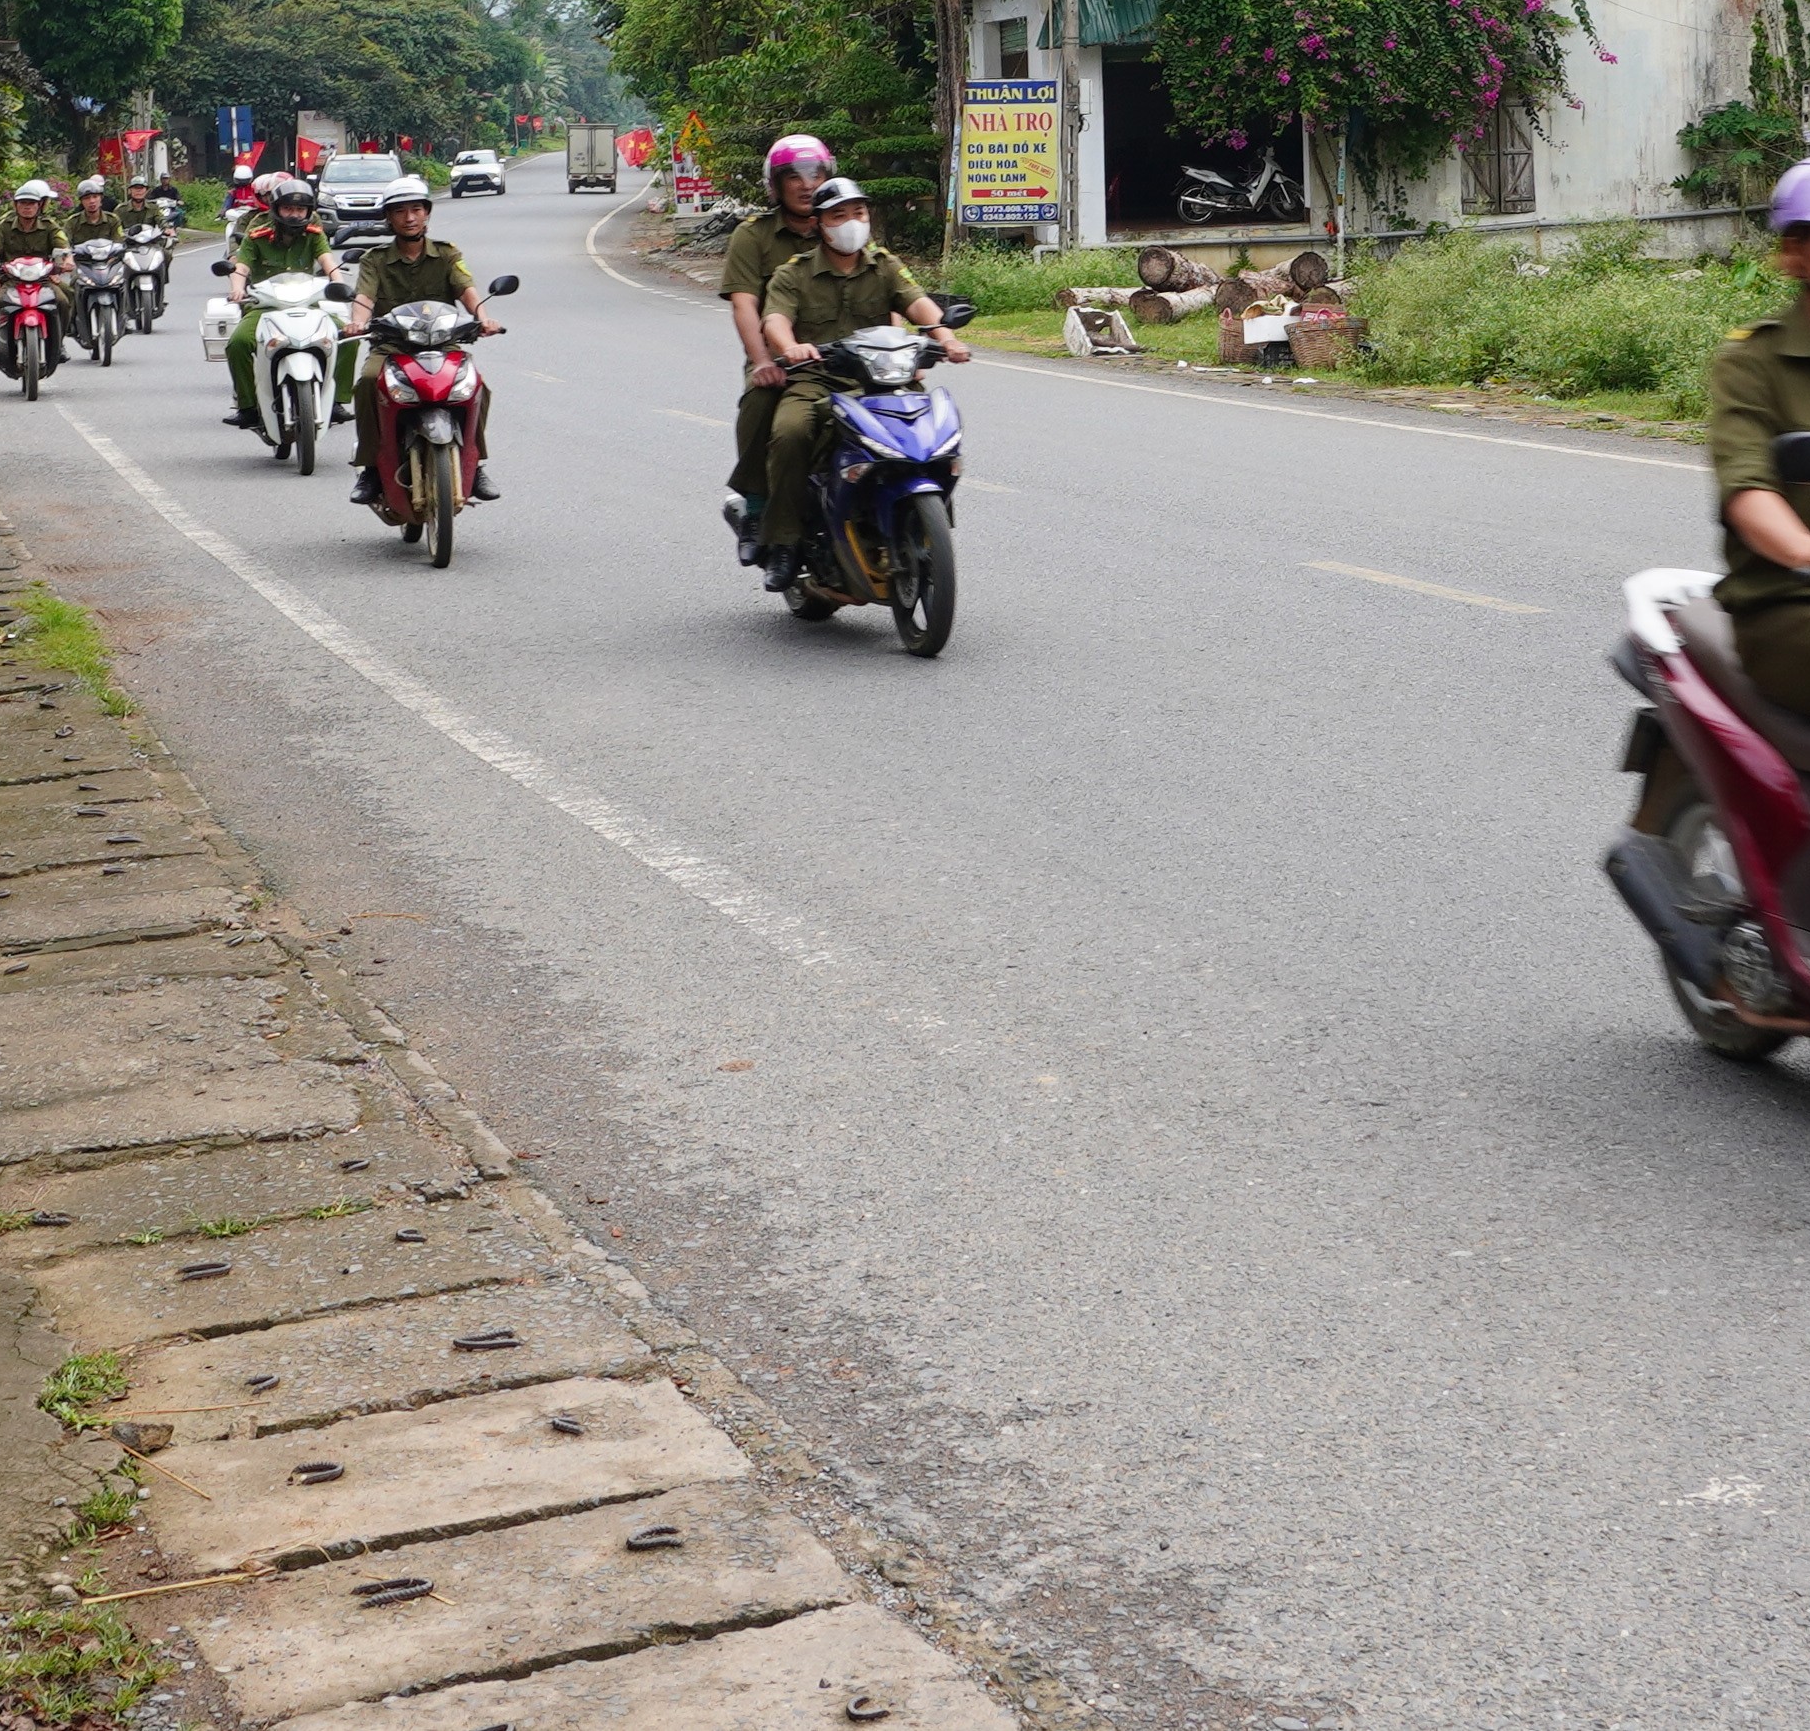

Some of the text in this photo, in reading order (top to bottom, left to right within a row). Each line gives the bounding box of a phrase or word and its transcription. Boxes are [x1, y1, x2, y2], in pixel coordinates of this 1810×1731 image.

[965, 84, 1055, 103] THUẬN LỢI
[968, 107, 1054, 137] NHÀ TRỌ
[1033, 142, 1047, 153] XE
[990, 189, 1005, 198] 50
